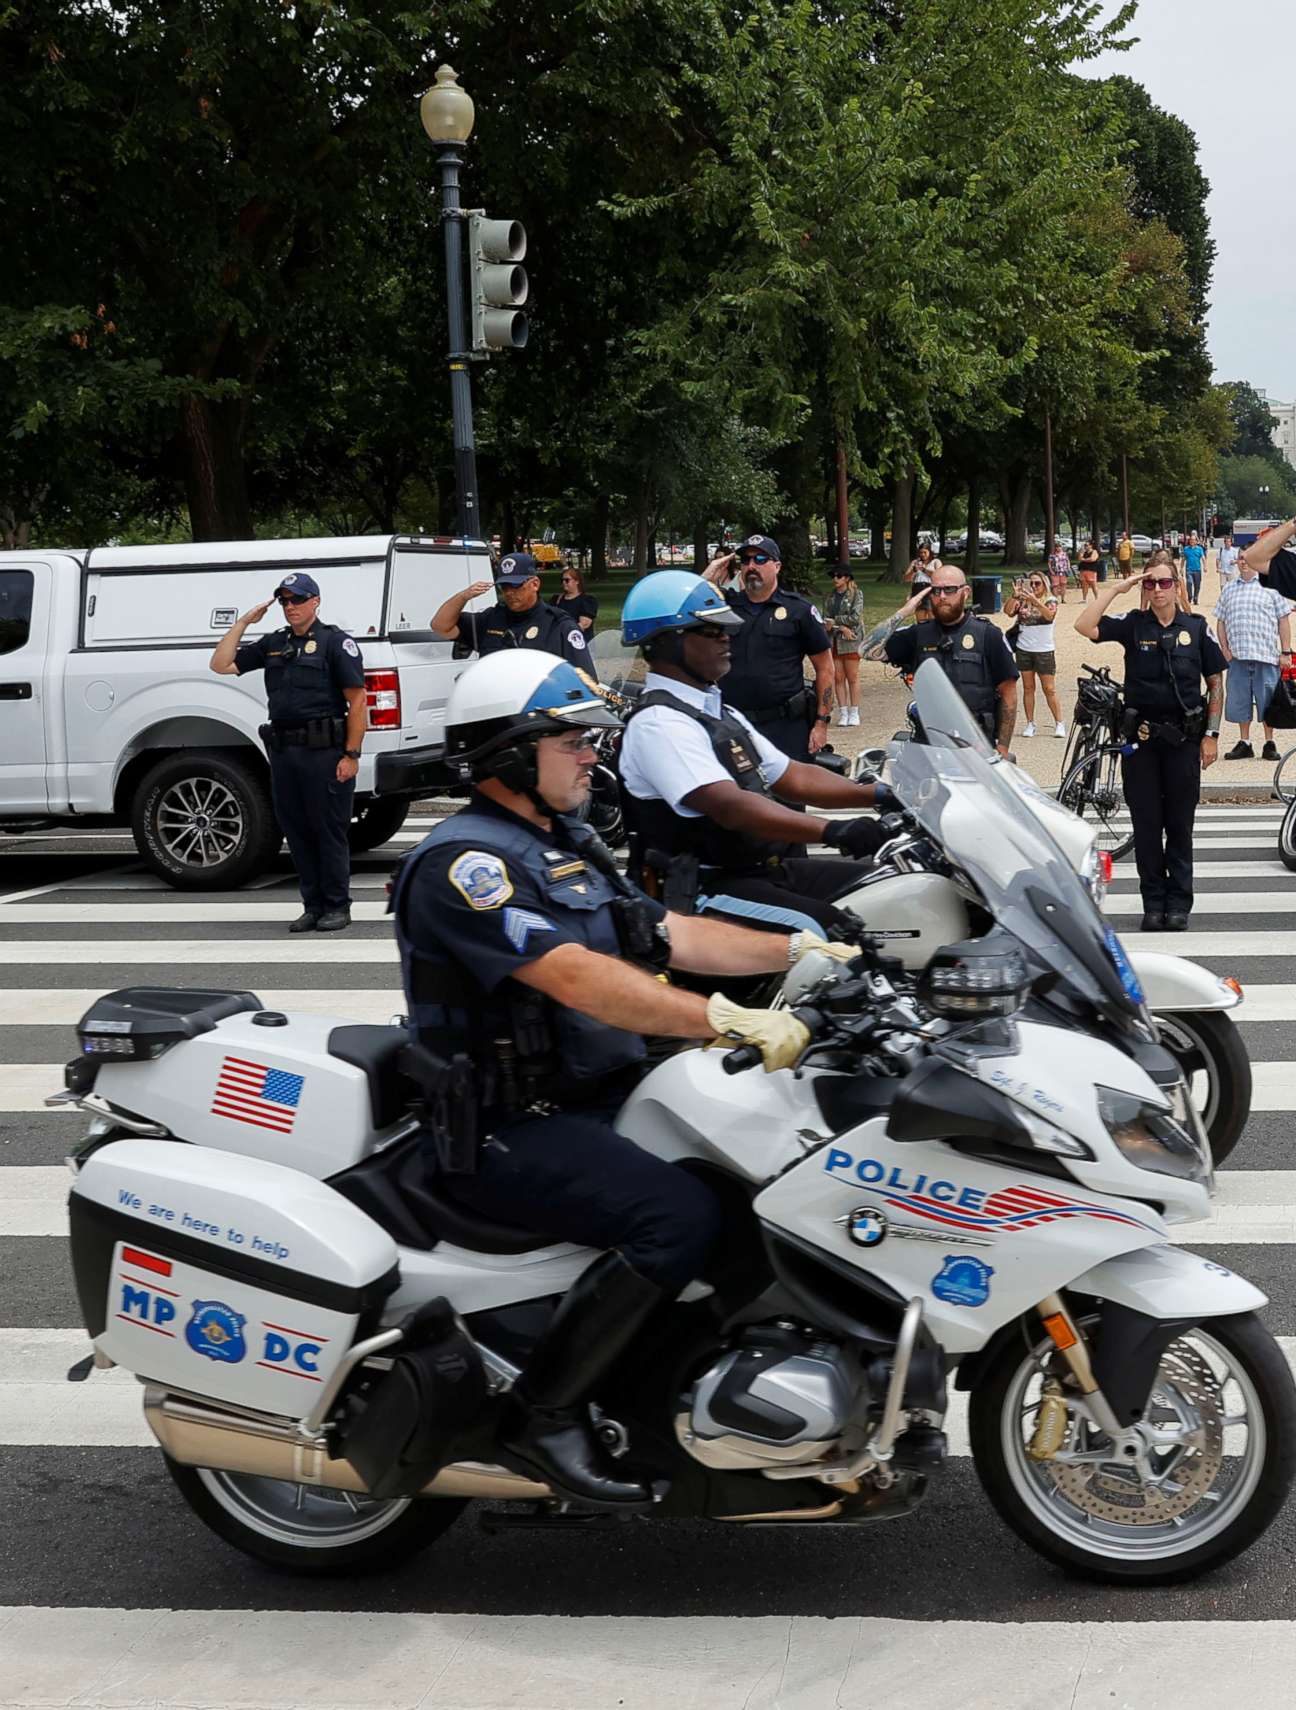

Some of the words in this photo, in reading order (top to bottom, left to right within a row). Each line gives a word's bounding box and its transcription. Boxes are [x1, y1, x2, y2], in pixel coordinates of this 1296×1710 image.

[594, 686, 624, 705] OLICE
[824, 1148, 987, 1211] POLICE
[119, 1188, 142, 1210] We
[148, 1203, 176, 1222] are
[181, 1212, 220, 1237] here
[227, 1228, 245, 1245] to
[251, 1235, 290, 1260] help
[121, 1283, 177, 1326] MP
[263, 1331, 323, 1373] DC
